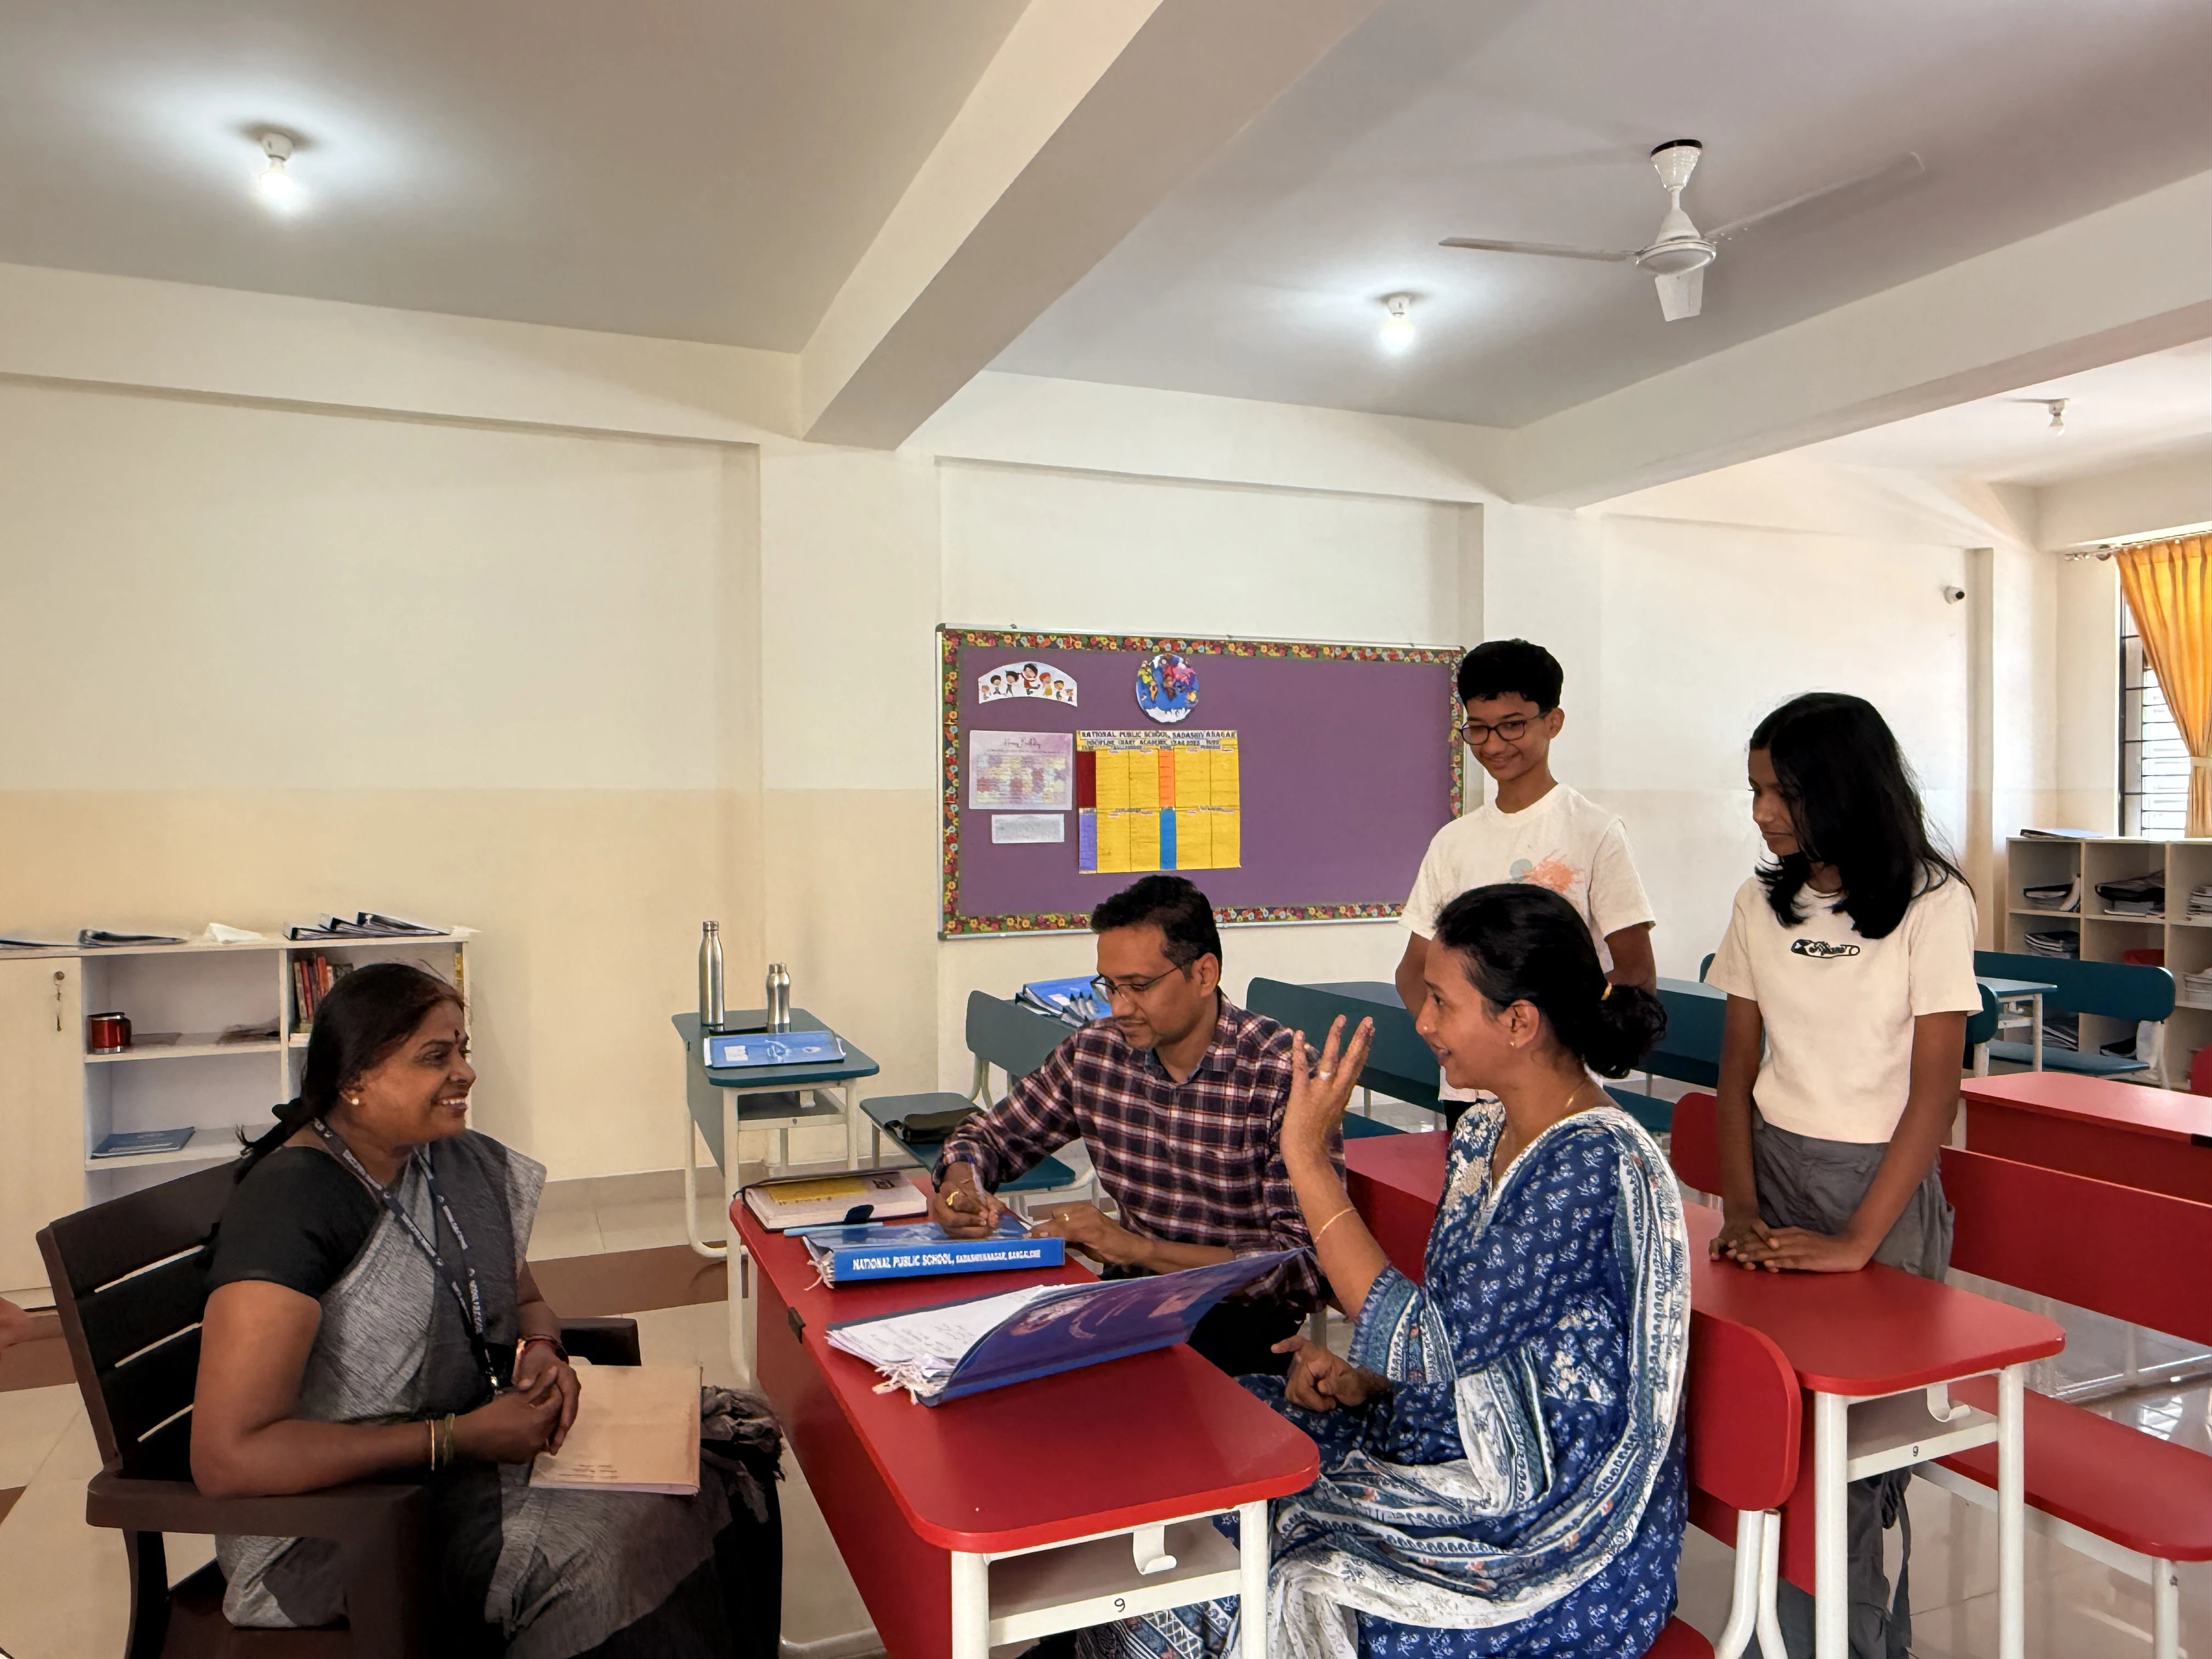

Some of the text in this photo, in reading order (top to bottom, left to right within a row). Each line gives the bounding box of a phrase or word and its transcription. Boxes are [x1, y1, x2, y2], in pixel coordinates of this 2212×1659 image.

[853, 1257, 891, 1270] NATIONAL
[893, 1255, 920, 1268] PUBLIC
[1912, 1446, 1918, 1457] 9
[1114, 1598, 1125, 1612] 9
